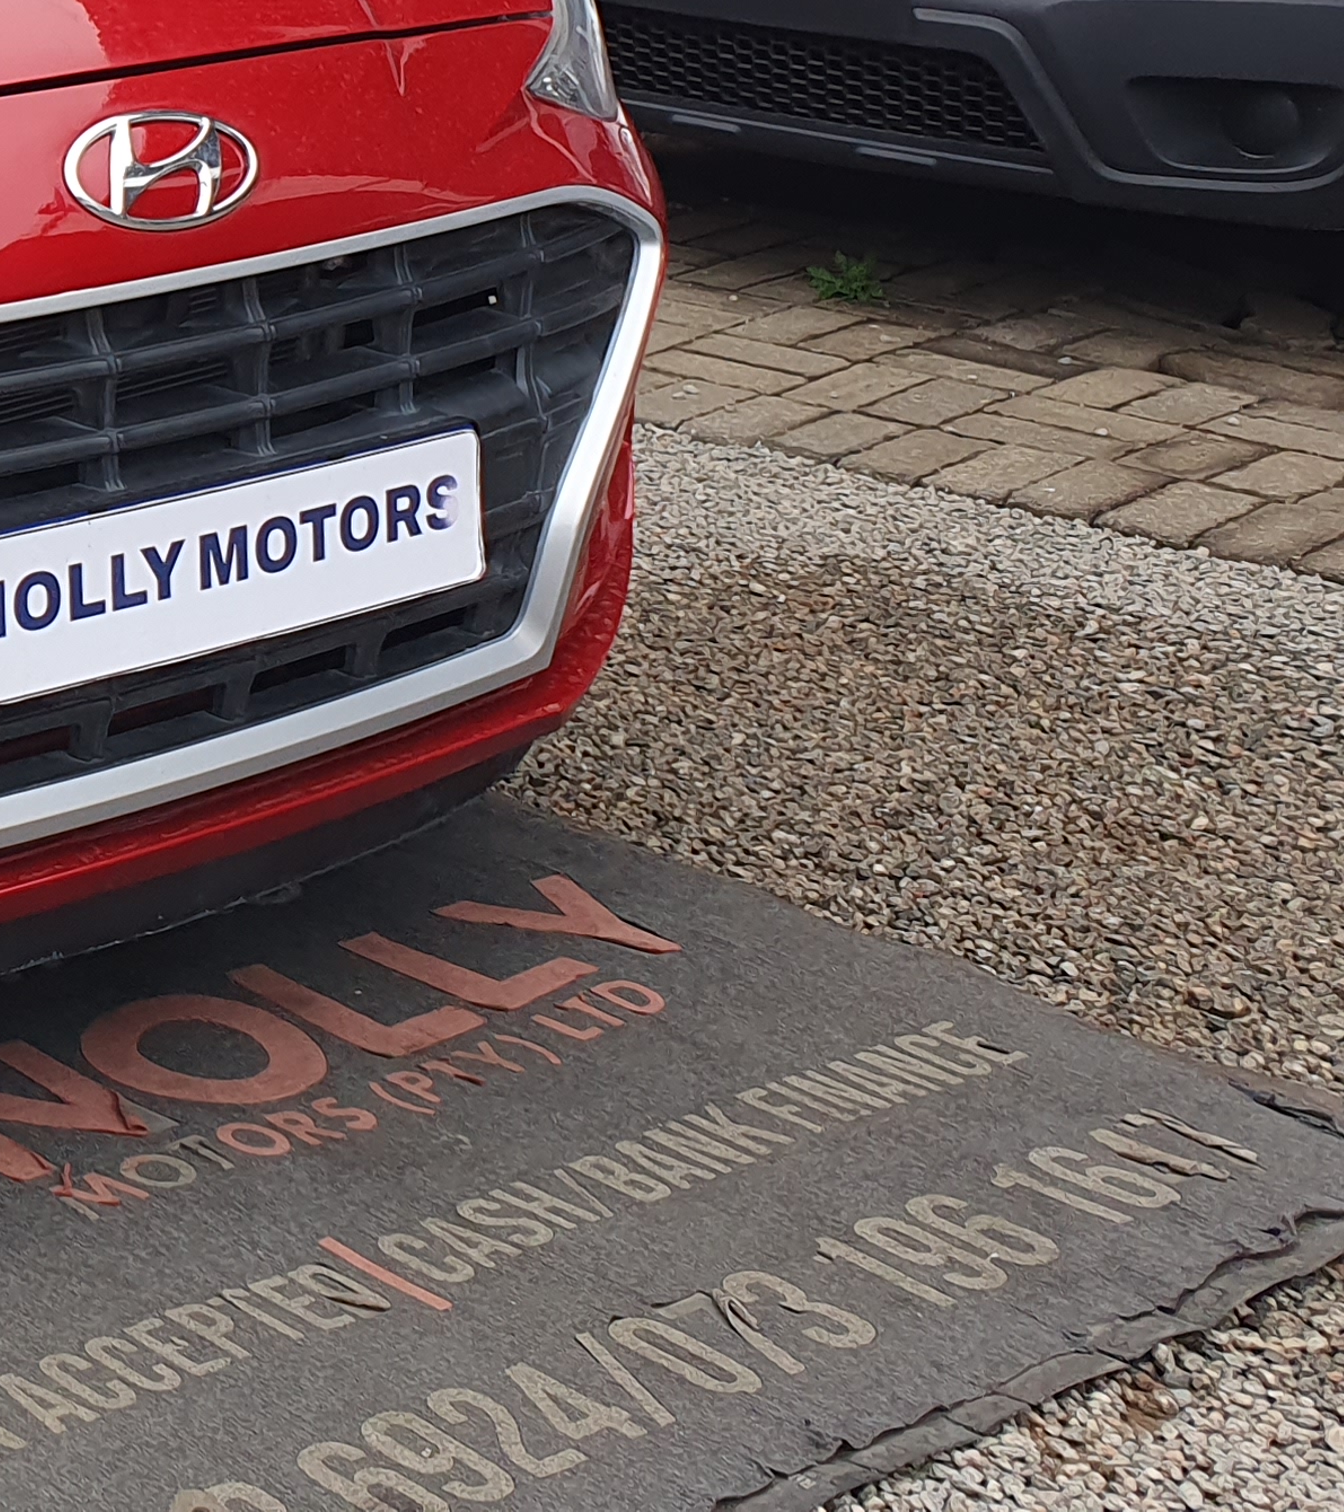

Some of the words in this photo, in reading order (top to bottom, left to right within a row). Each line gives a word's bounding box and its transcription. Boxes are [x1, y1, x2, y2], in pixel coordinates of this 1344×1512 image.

[198, 474, 459, 590] MOTORS
[50, 1095, 379, 1222] MOTORS
[366, 1032, 565, 1115] (PTY)
[529, 978, 667, 1042] LTD
[376, 1101, 796, 1285] CASH/BANK
[735, 1020, 1030, 1134] FINANCE
[295, 1269, 878, 1512] 6924/073
[813, 1193, 1061, 1308] 196
